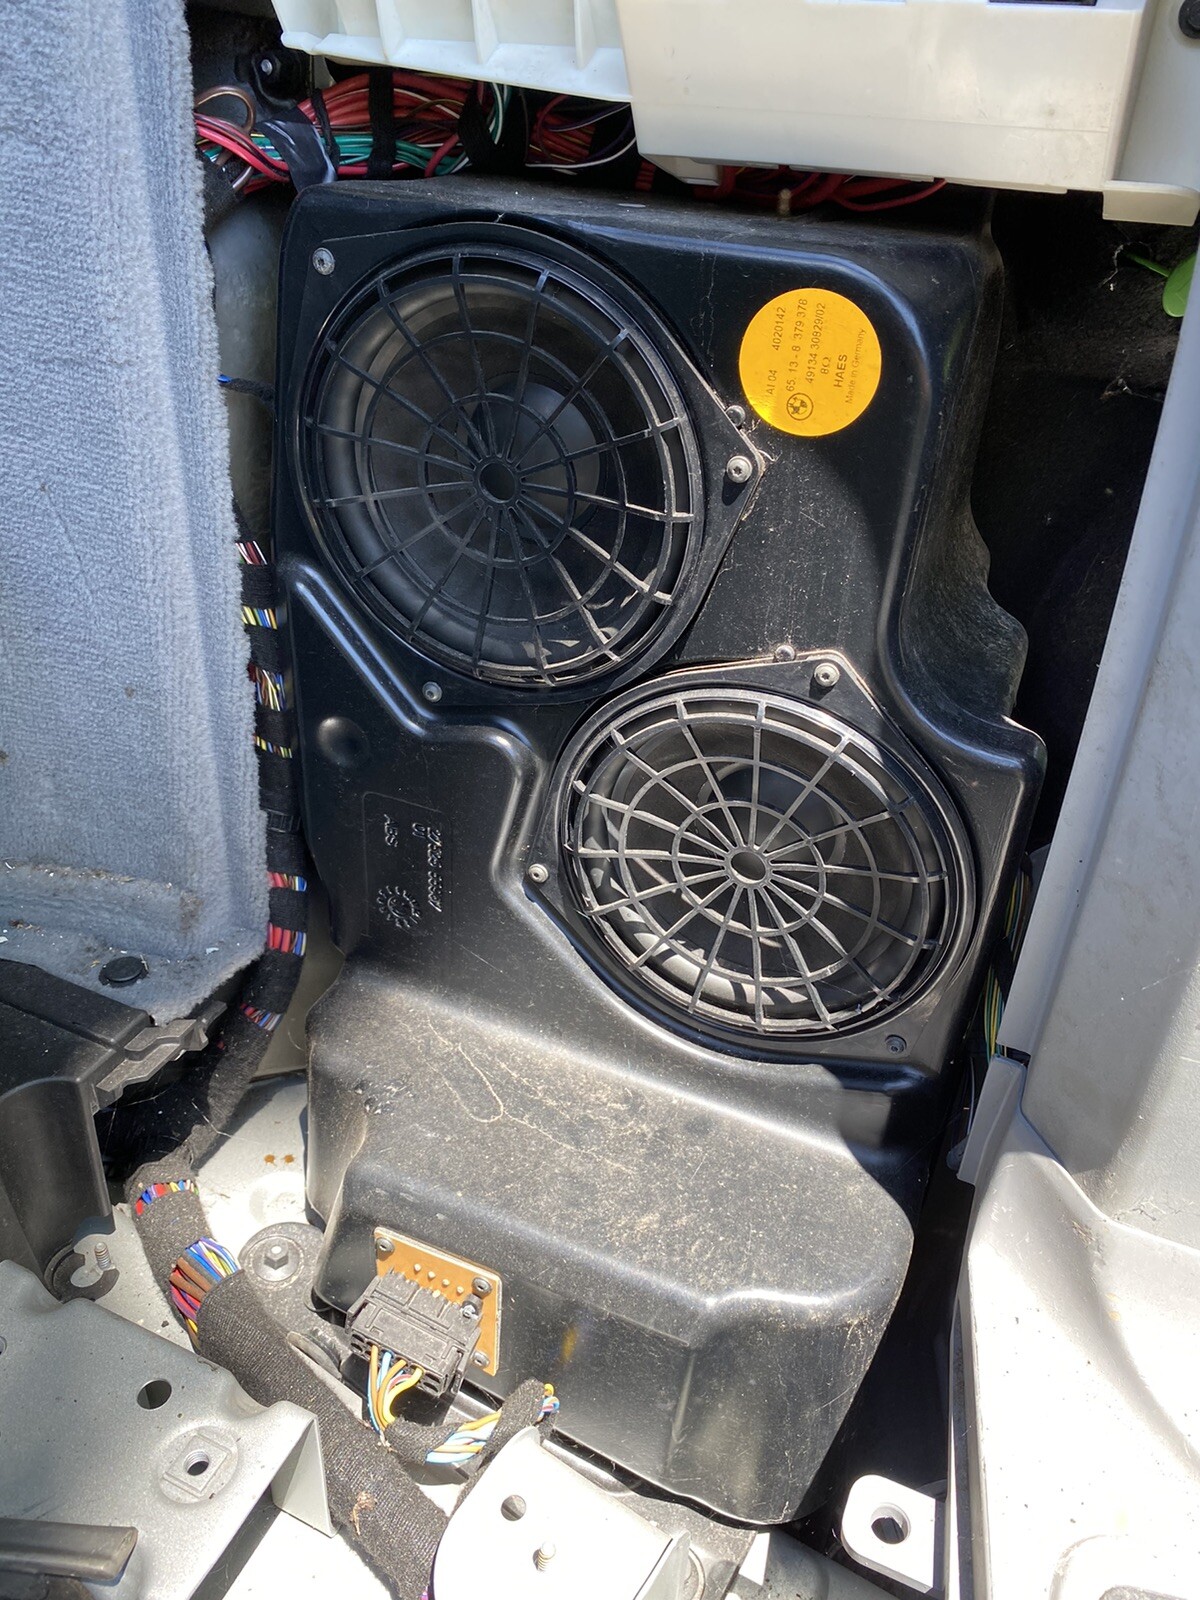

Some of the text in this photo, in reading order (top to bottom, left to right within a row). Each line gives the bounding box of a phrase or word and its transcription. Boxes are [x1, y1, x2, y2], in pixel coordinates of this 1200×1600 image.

[796, 298, 808, 318] 378
[772, 306, 786, 351] 4020142
[793, 320, 805, 340] 379
[791, 345, 801, 353] 8
[805, 302, 826, 384] 49134 30829/02
[788, 361, 799, 373] 13
[833, 353, 848, 388] HAES
[844, 328, 867, 404] Made in Germany
